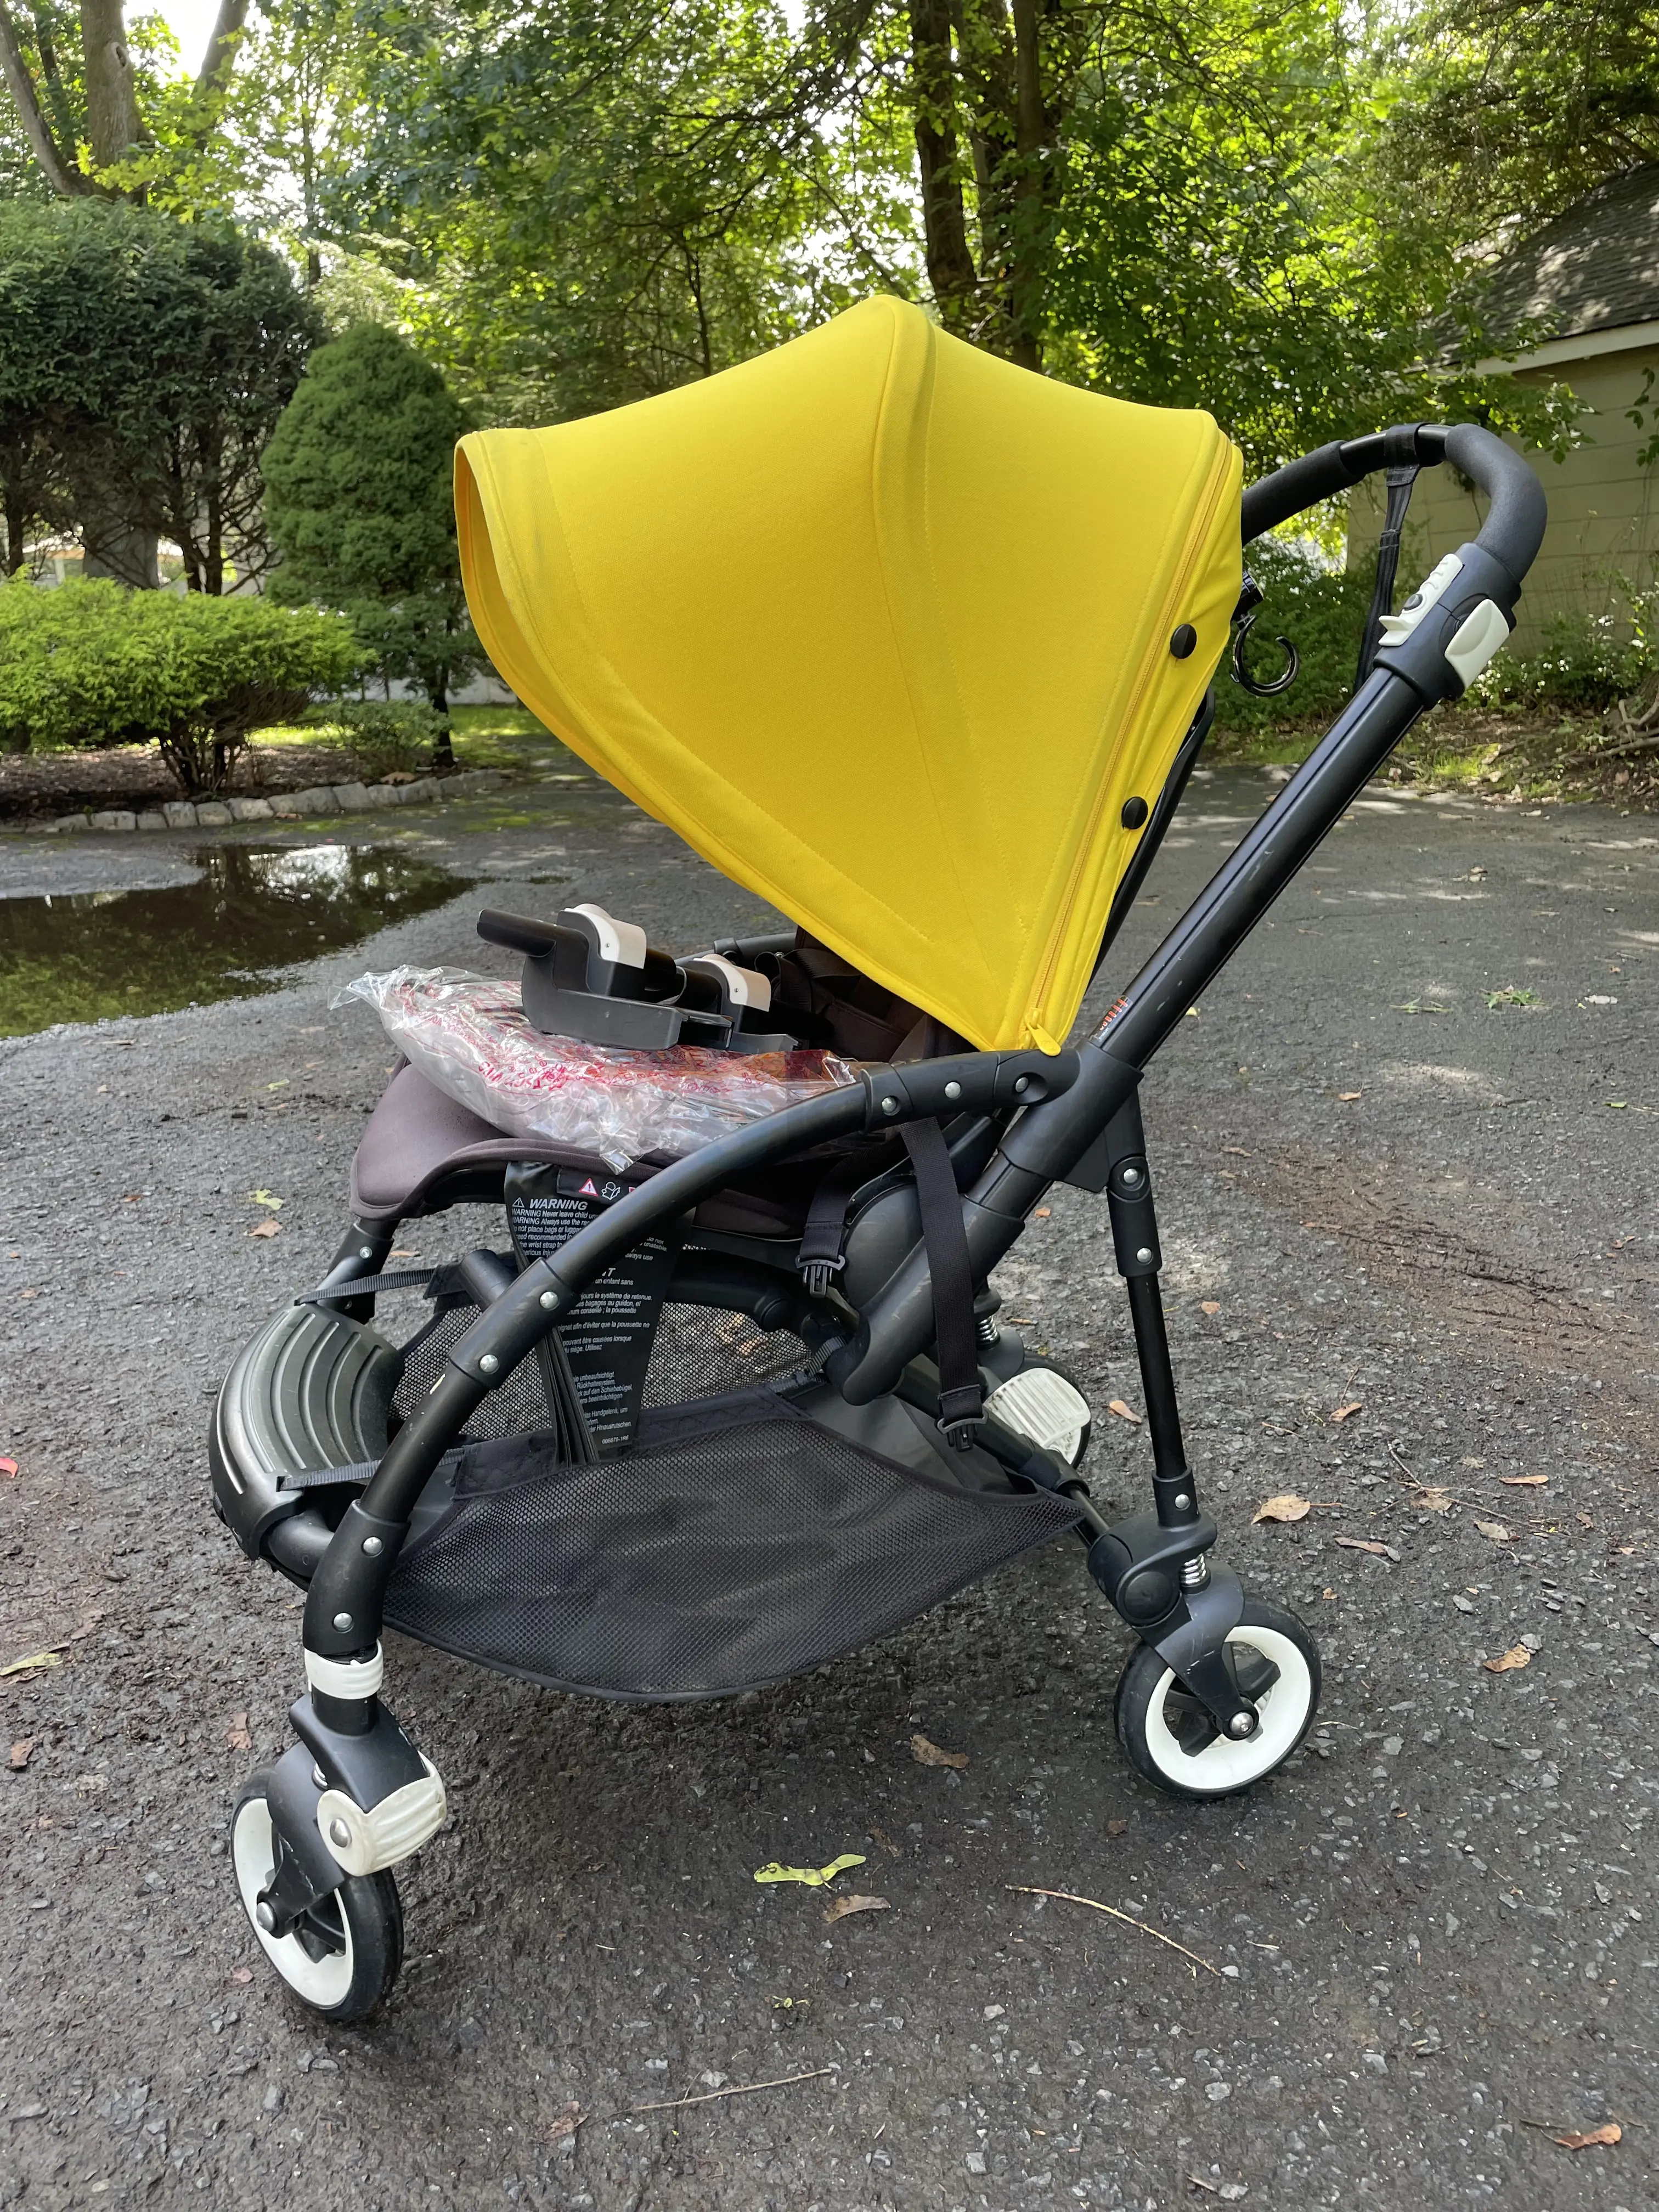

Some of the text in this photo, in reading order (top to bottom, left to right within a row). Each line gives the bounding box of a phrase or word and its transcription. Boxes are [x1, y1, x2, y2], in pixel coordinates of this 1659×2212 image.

[529, 1199, 588, 1210] WARNING
[512, 1209, 541, 1217] WARNING
[540, 1218, 560, 1227] Always
[544, 1226, 557, 1234] bags
[600, 1292, 623, 1300] système
[613, 1335, 632, 1343] lorsque
